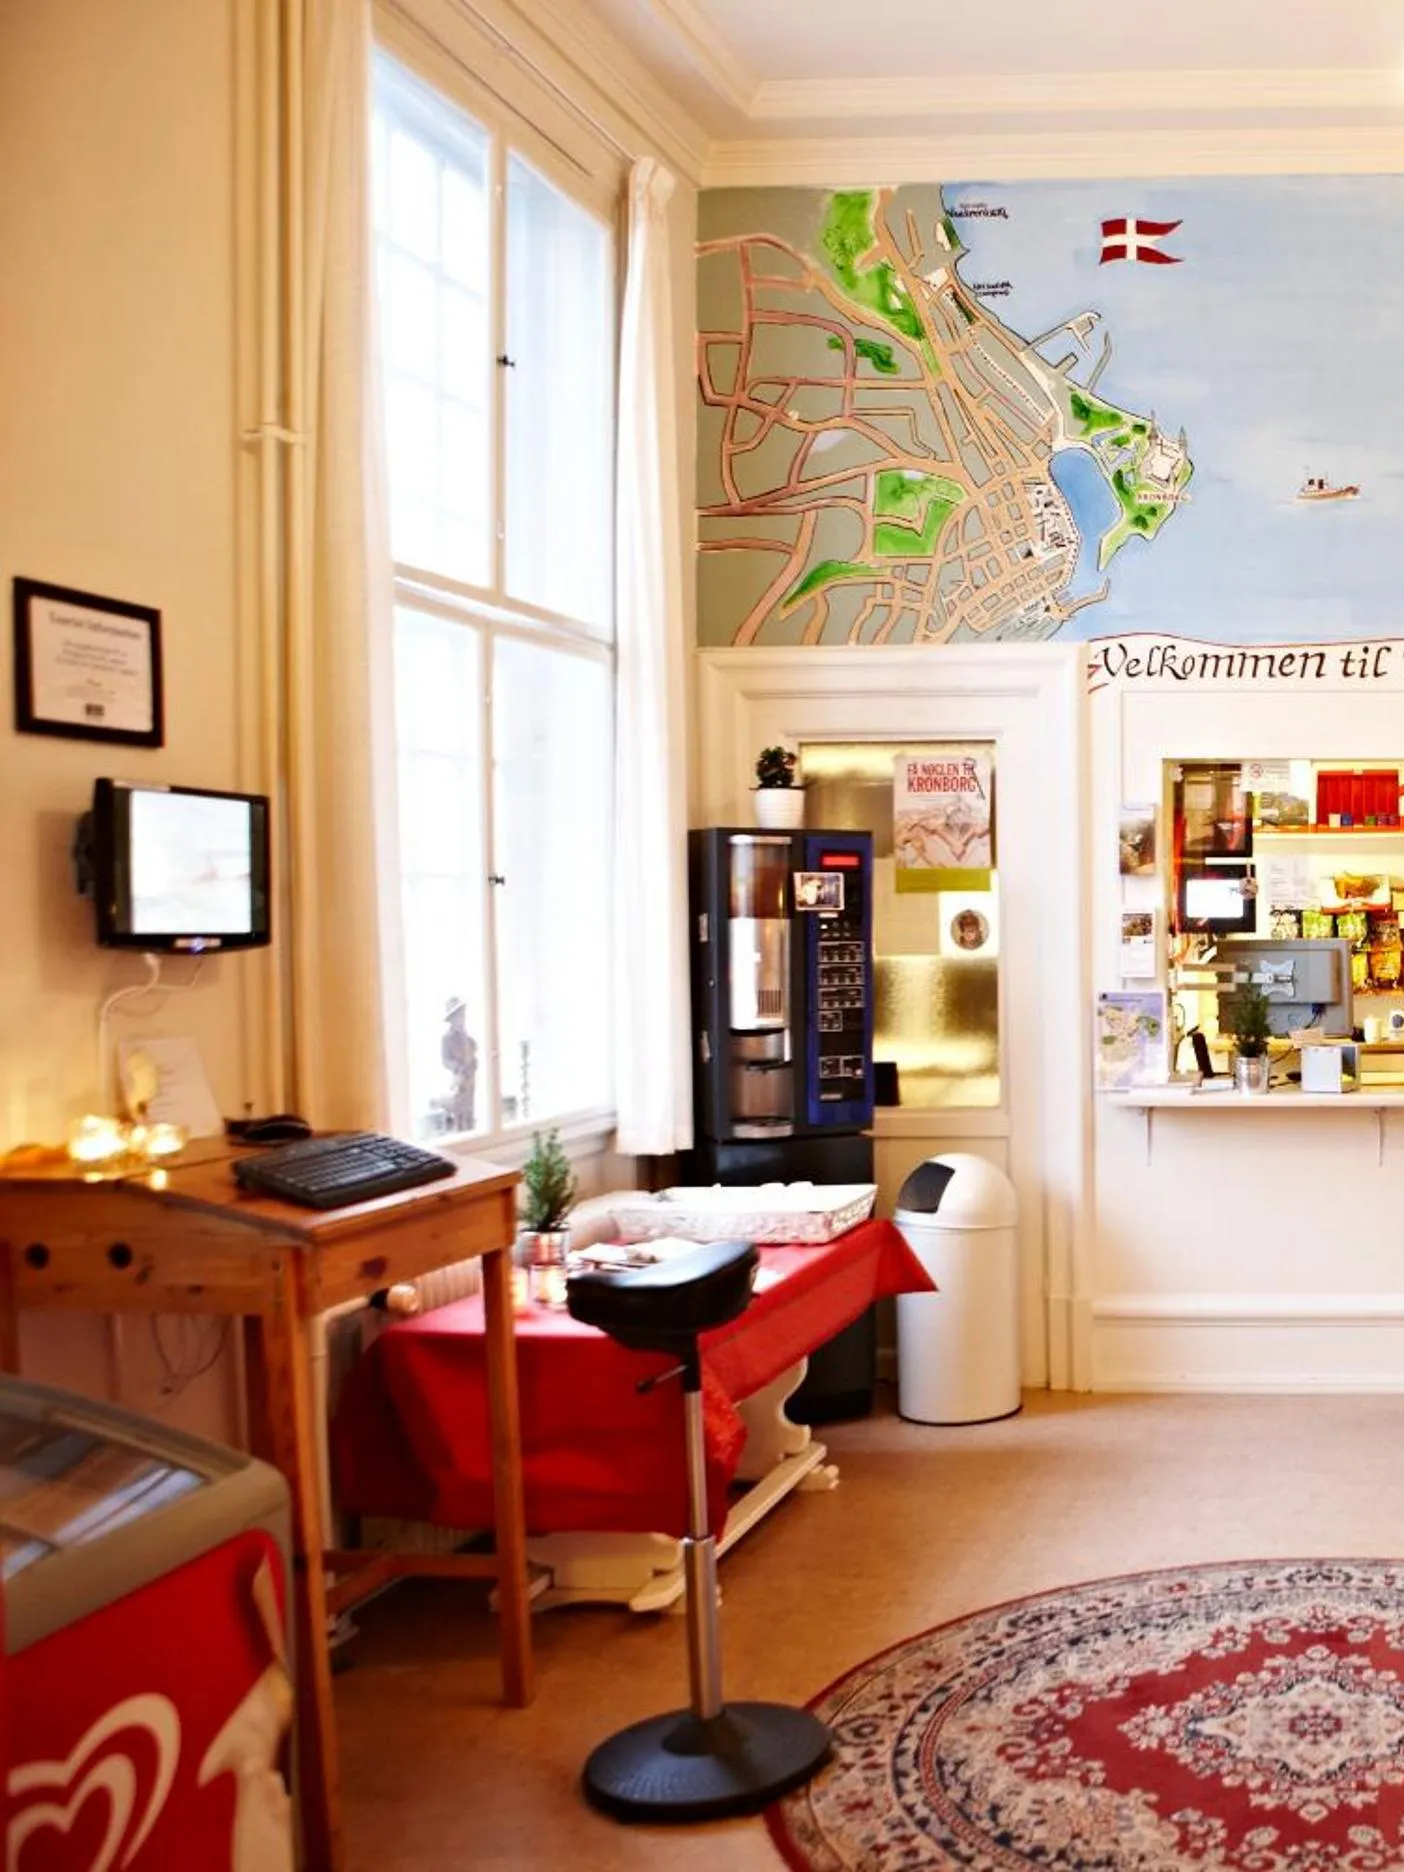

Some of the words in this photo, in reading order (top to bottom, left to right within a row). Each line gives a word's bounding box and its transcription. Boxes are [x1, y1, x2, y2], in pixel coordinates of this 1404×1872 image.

[1101, 643, 1327, 680] Velkommen
[1340, 645, 1391, 679] til
[907, 776, 977, 793] KRONBORG
